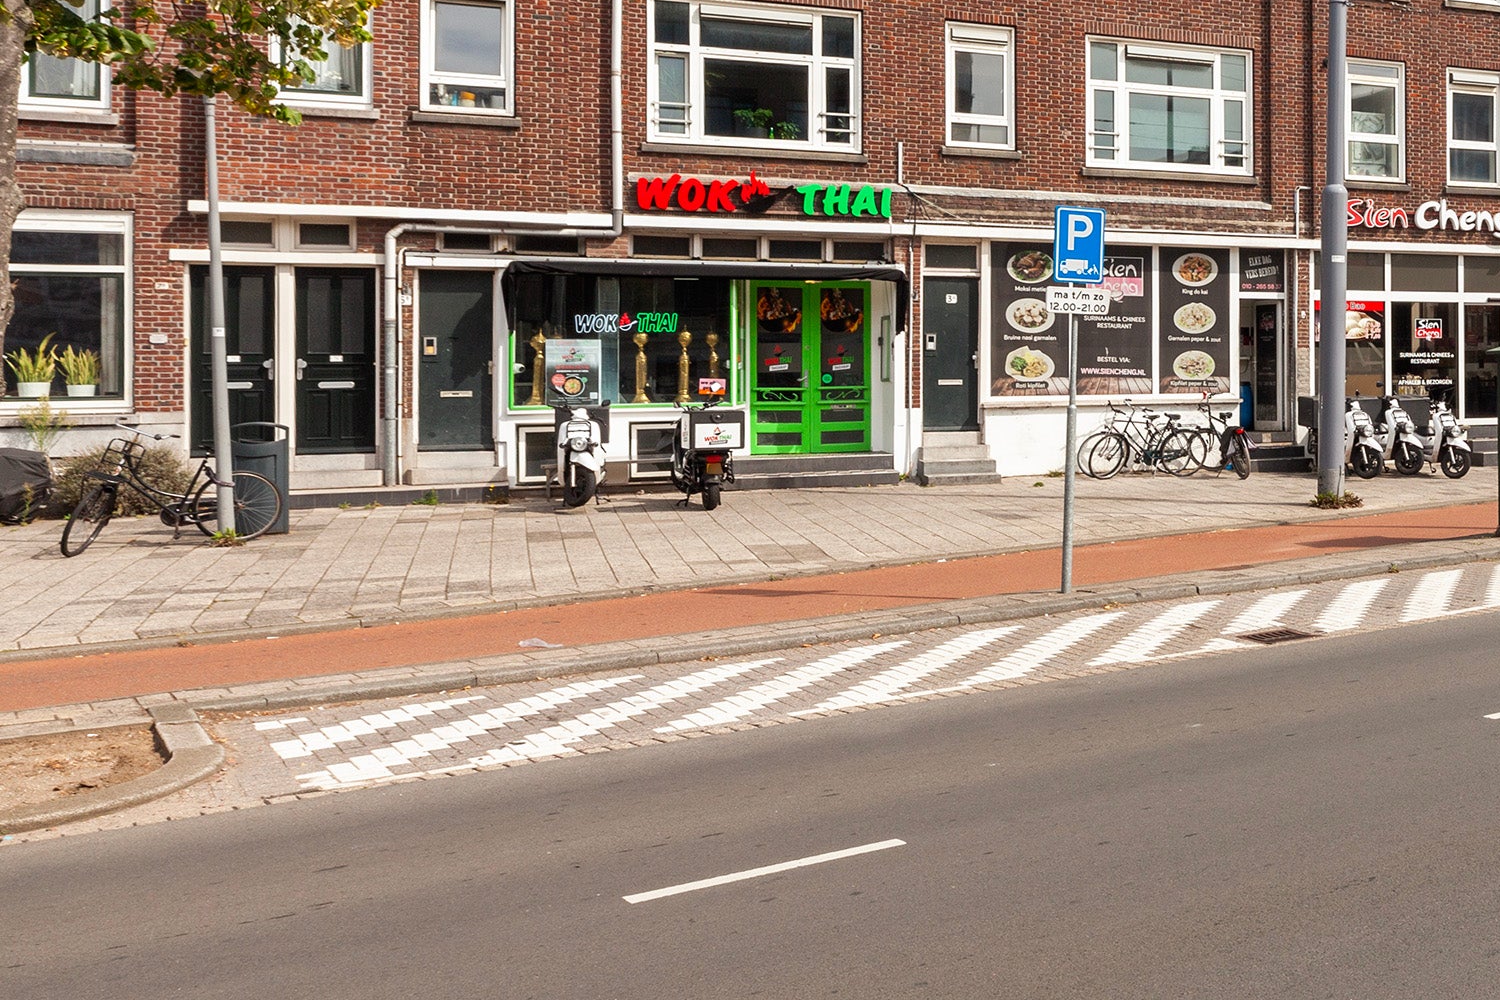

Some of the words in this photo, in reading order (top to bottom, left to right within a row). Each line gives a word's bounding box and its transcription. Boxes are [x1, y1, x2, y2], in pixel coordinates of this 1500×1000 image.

[636, 174, 739, 212] WOK
[796, 183, 892, 218] THAI
[1347, 199, 1408, 229] Sien
[1067, 214, 1094, 251] P
[1072, 291, 1090, 300] t/m
[1050, 302, 1106, 313] 12.00-21.00
[575, 314, 619, 333] WOK
[637, 312, 679, 333] THAI
[1418, 319, 1439, 329] Sien
[1080, 367, 1146, 376] WWW.SIENCHENG.NL
